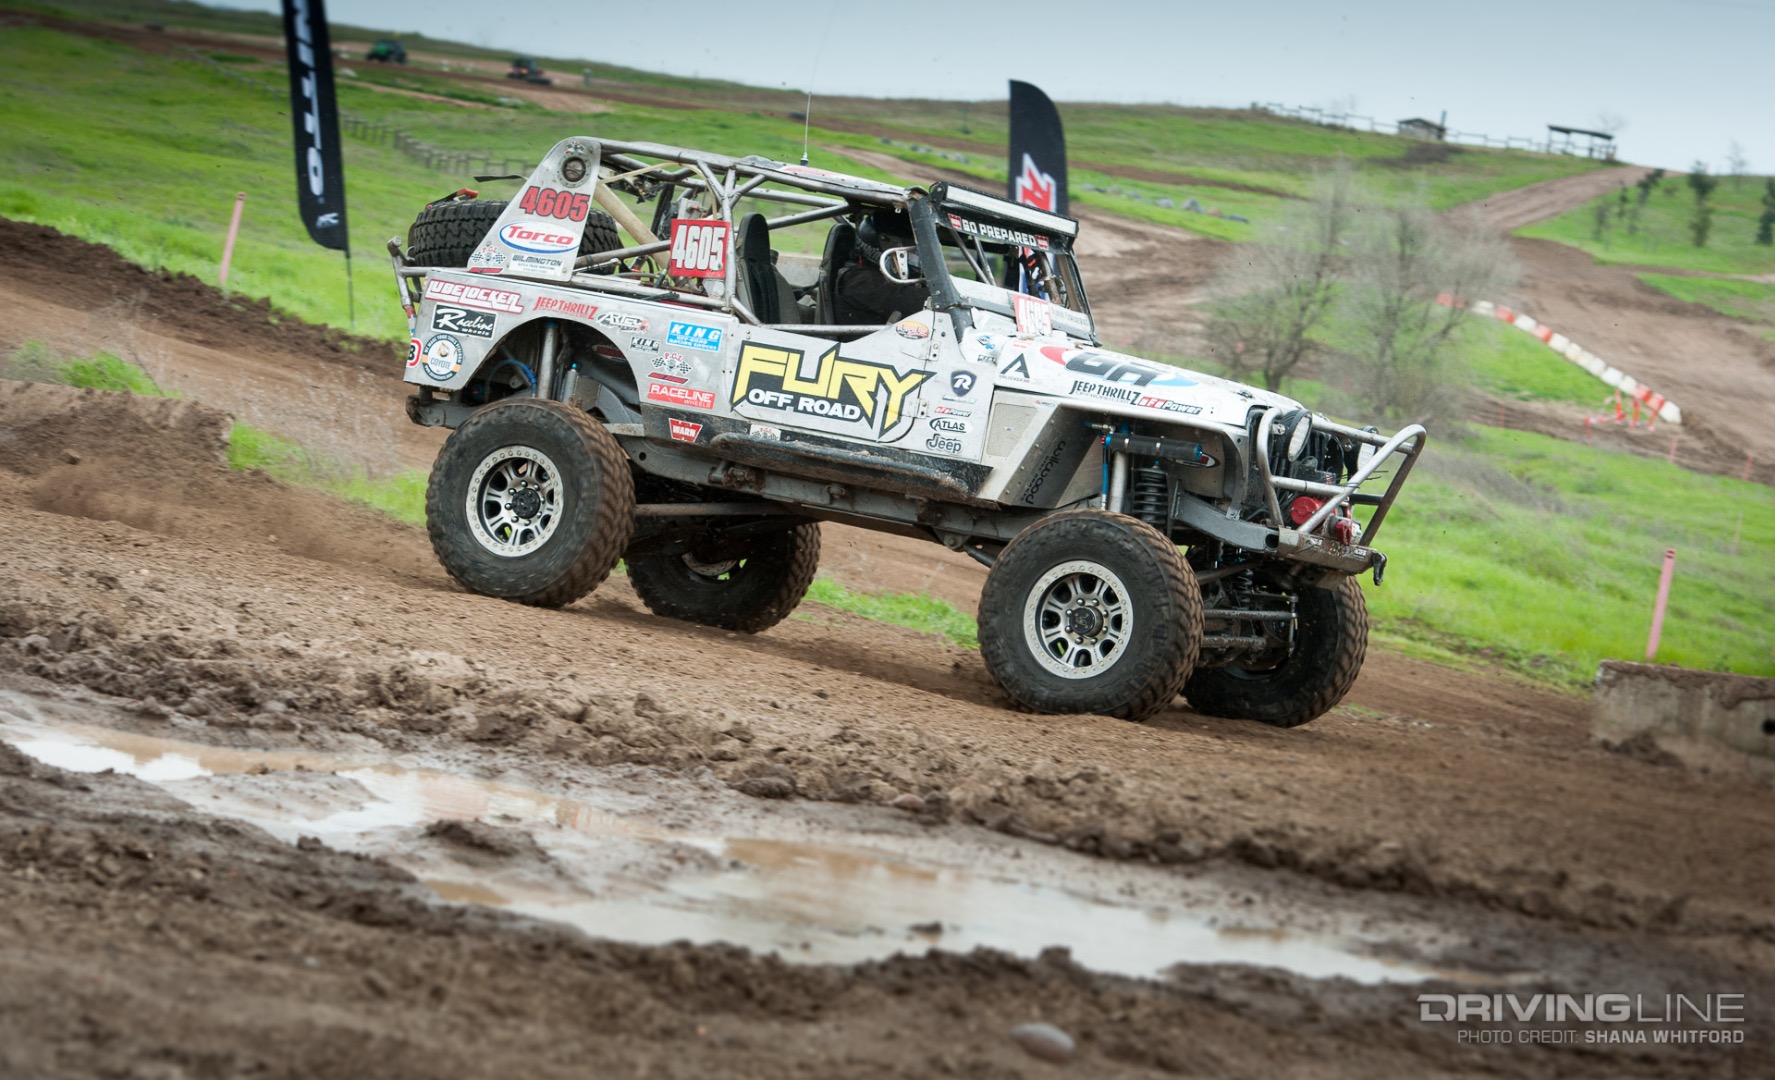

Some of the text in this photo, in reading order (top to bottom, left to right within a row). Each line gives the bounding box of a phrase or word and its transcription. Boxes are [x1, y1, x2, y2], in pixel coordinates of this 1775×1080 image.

[519, 185, 591, 223] 4605
[508, 225, 574, 246] Torco
[961, 218, 978, 234] GO
[978, 223, 1038, 247] PREPARED
[671, 224, 727, 271] 4605
[512, 254, 563, 267] WILMINGTON
[533, 296, 559, 311] JEEP
[671, 324, 721, 341] KING
[632, 337, 660, 348] KING
[430, 357, 451, 369] COYOTE
[650, 384, 714, 404] RACELINE
[732, 343, 929, 432] FURY
[1069, 380, 1095, 395] JEEP
[1096, 386, 1141, 406] THRILLZ
[683, 398, 711, 408] WHEELS
[748, 388, 861, 420] OFF ROAD
[672, 425, 696, 437] WARN
[934, 420, 966, 431] ATLAS
[927, 434, 962, 453] Jeep
[1025, 440, 1066, 505] wilwood
